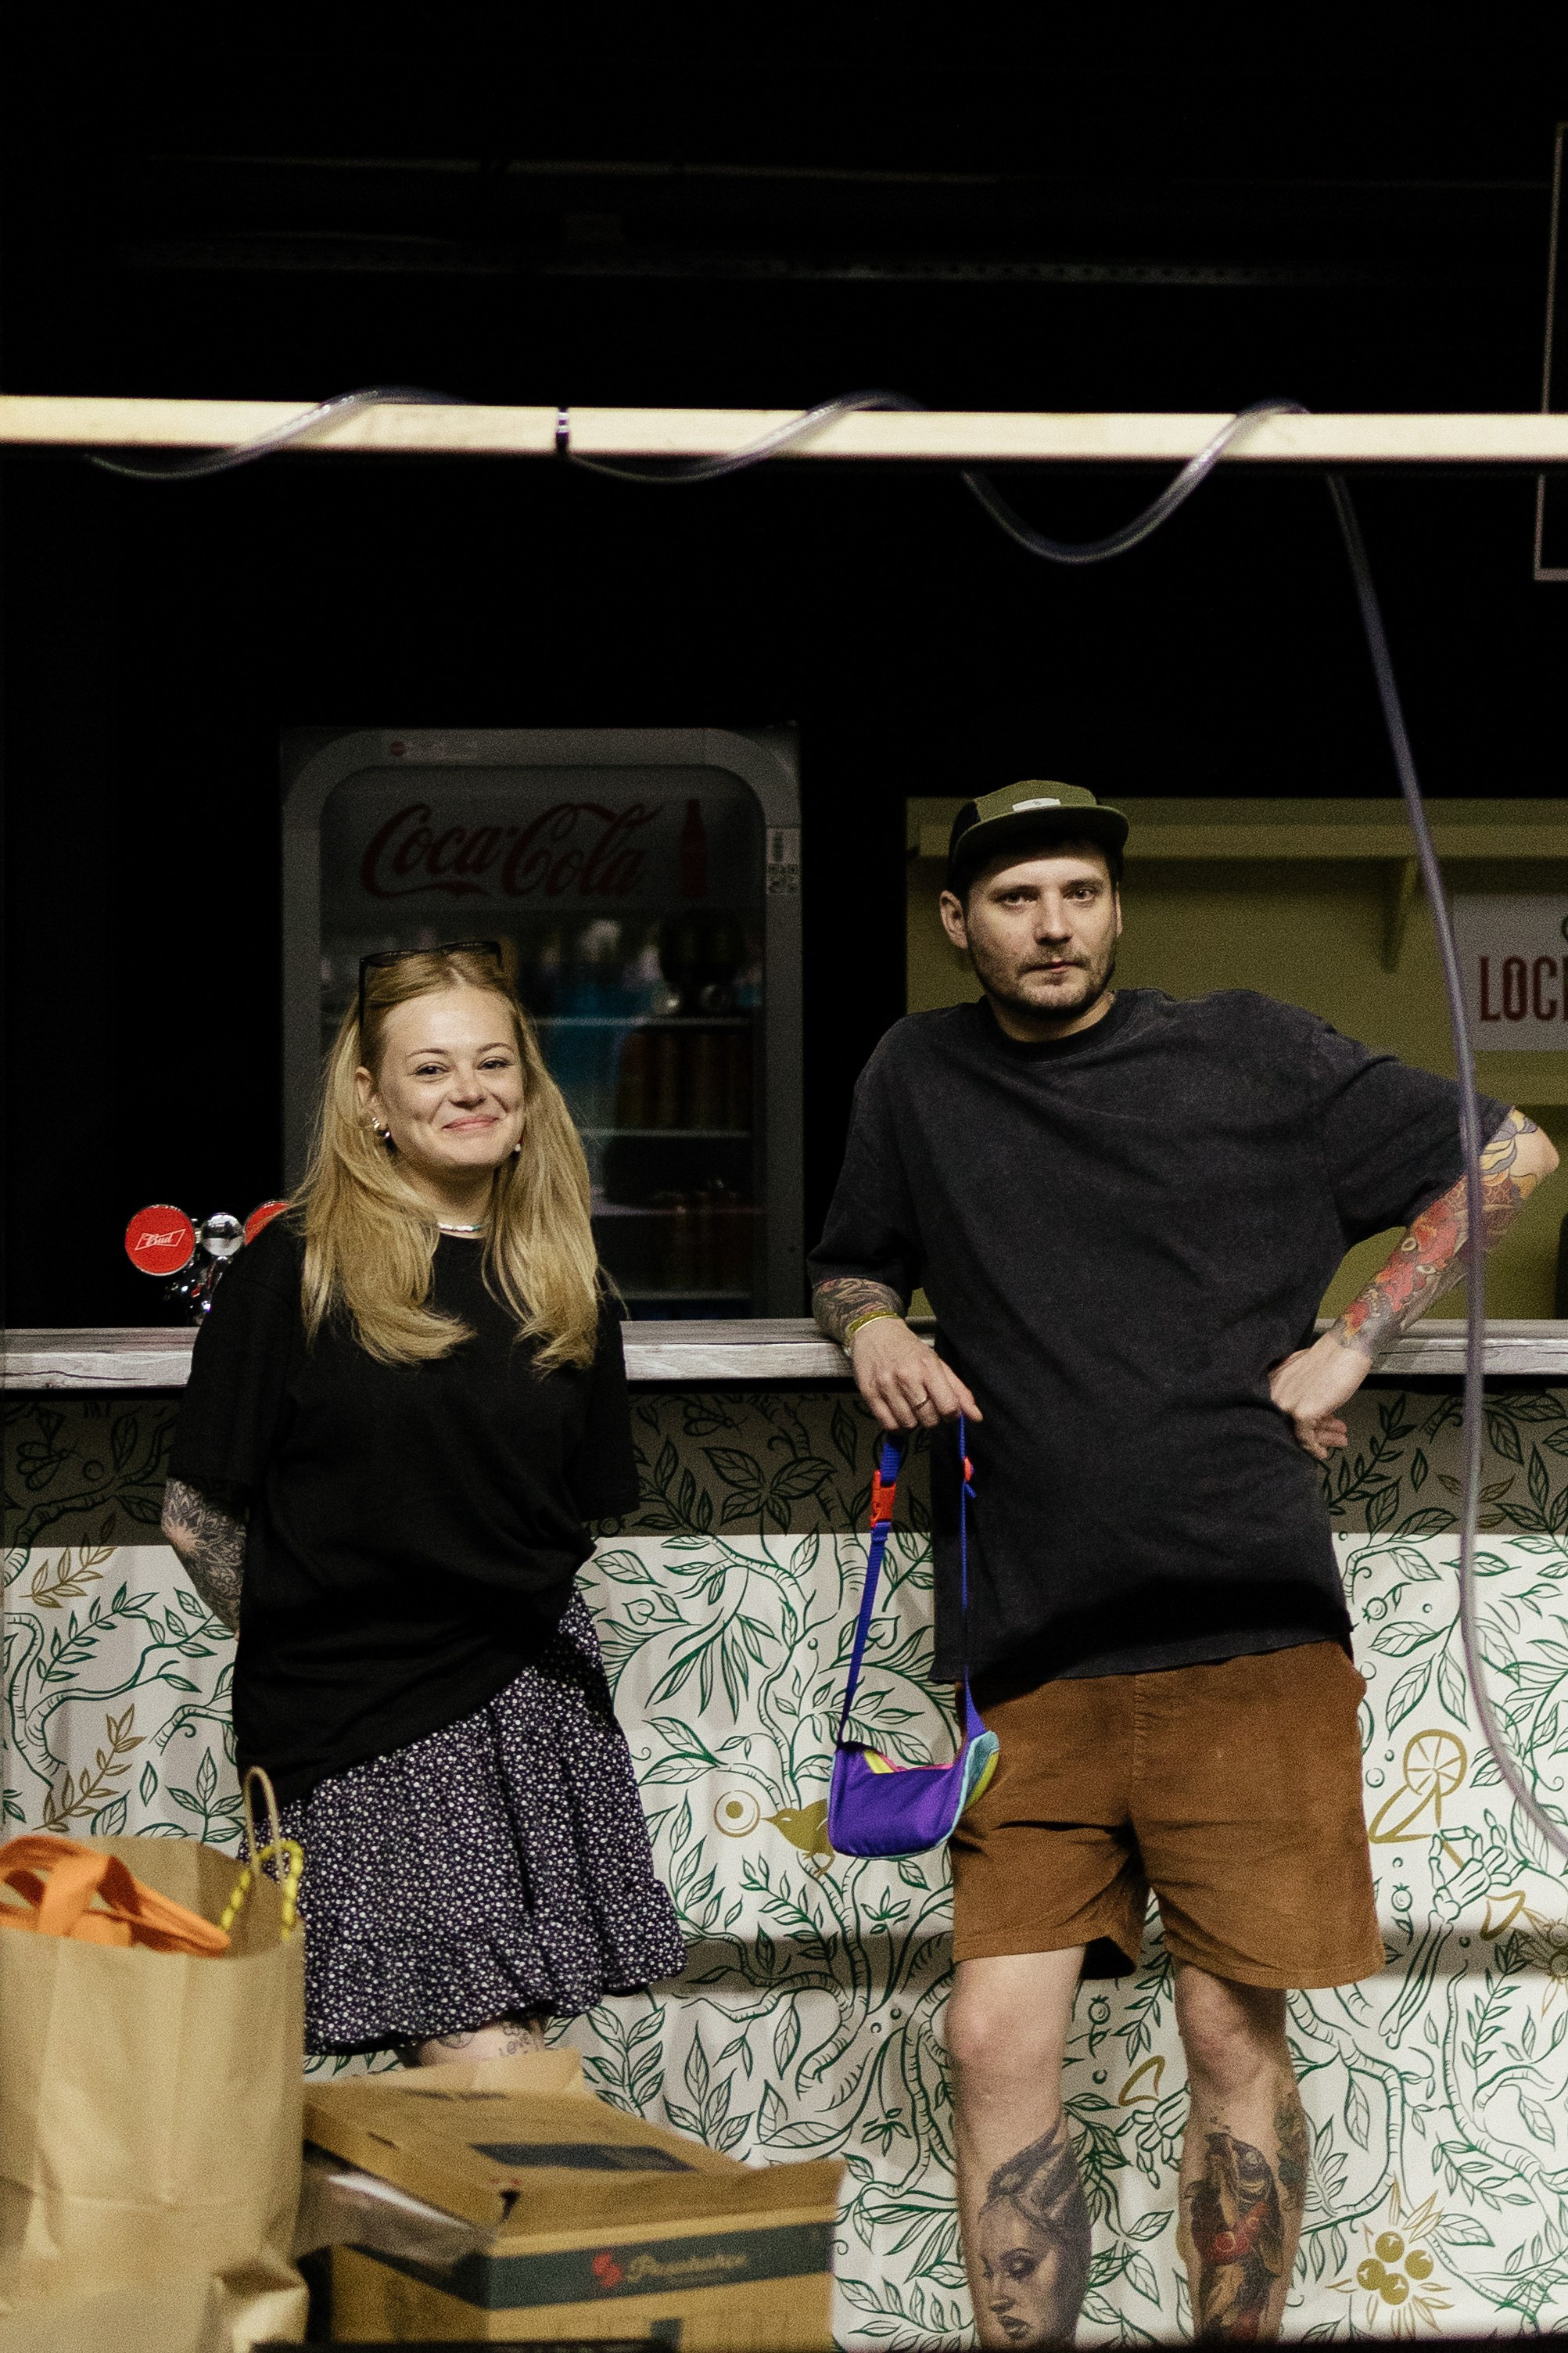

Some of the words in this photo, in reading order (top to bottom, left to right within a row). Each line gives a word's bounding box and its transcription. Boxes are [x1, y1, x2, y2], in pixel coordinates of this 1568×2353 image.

[361, 803, 662, 898] Coca-Cola
[1480, 955, 1568, 1021] LOC
[144, 1232, 174, 1246] Bud
